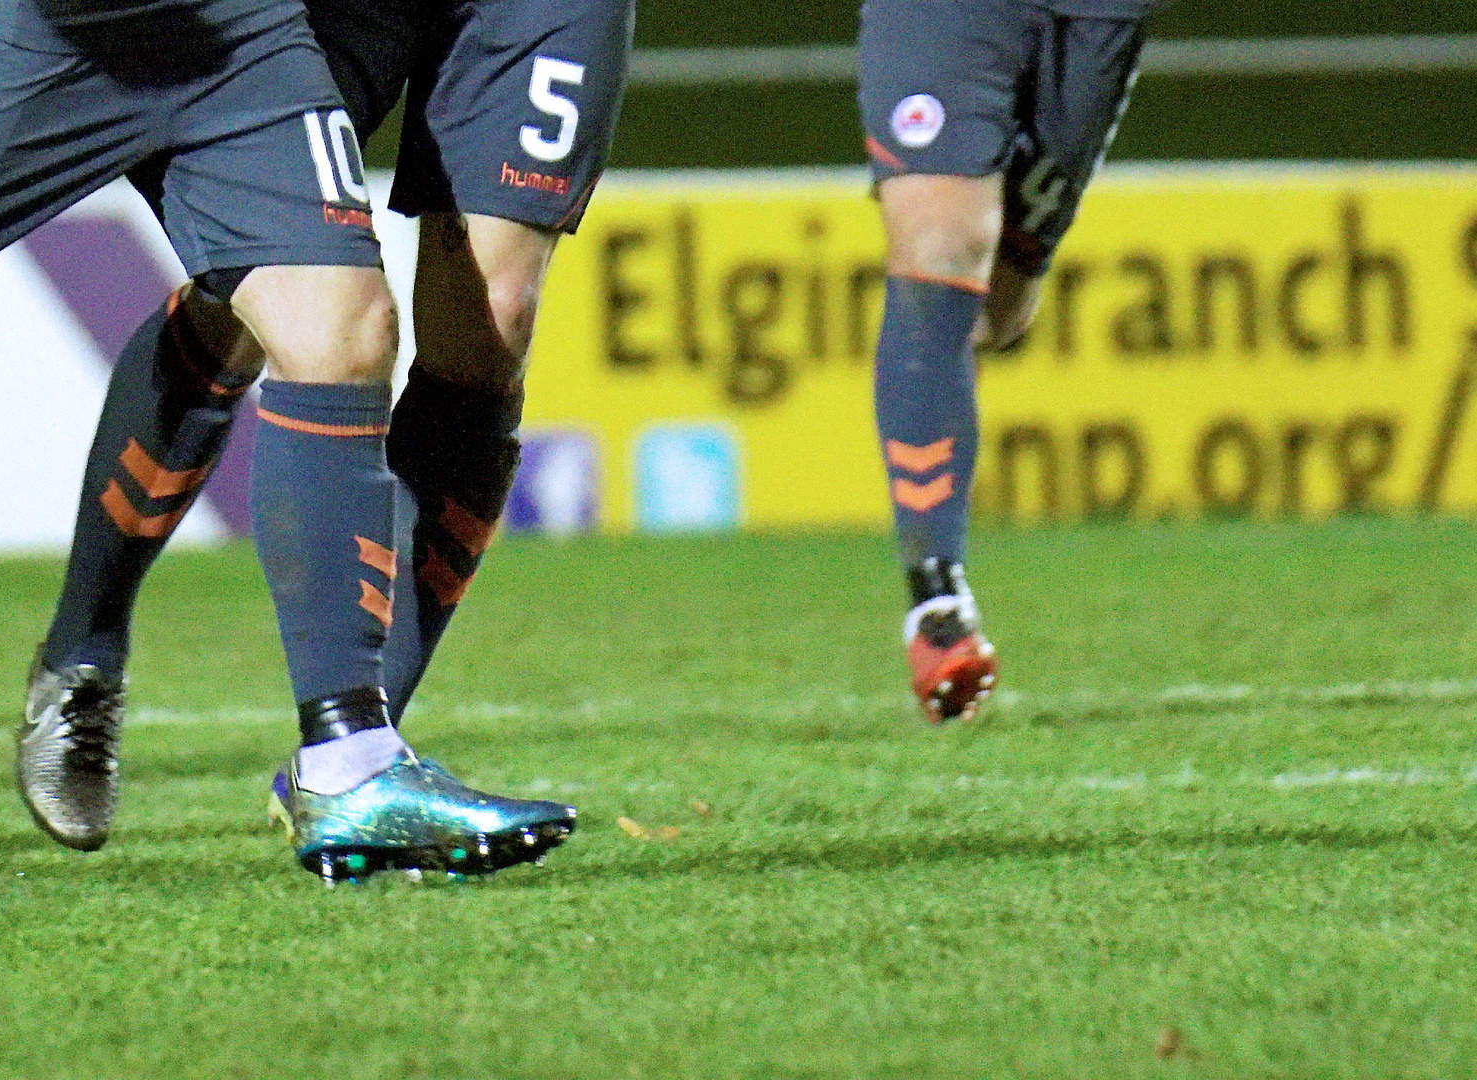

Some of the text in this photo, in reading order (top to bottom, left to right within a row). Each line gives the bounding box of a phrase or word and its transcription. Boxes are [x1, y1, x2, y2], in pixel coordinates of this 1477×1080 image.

[304, 107, 371, 205] 10
[519, 55, 586, 162] 5
[500, 161, 571, 196] hummel
[600, 206, 887, 410] Elgin
[1024, 192, 1410, 360] ranch
[989, 365, 1477, 524] np.org/
